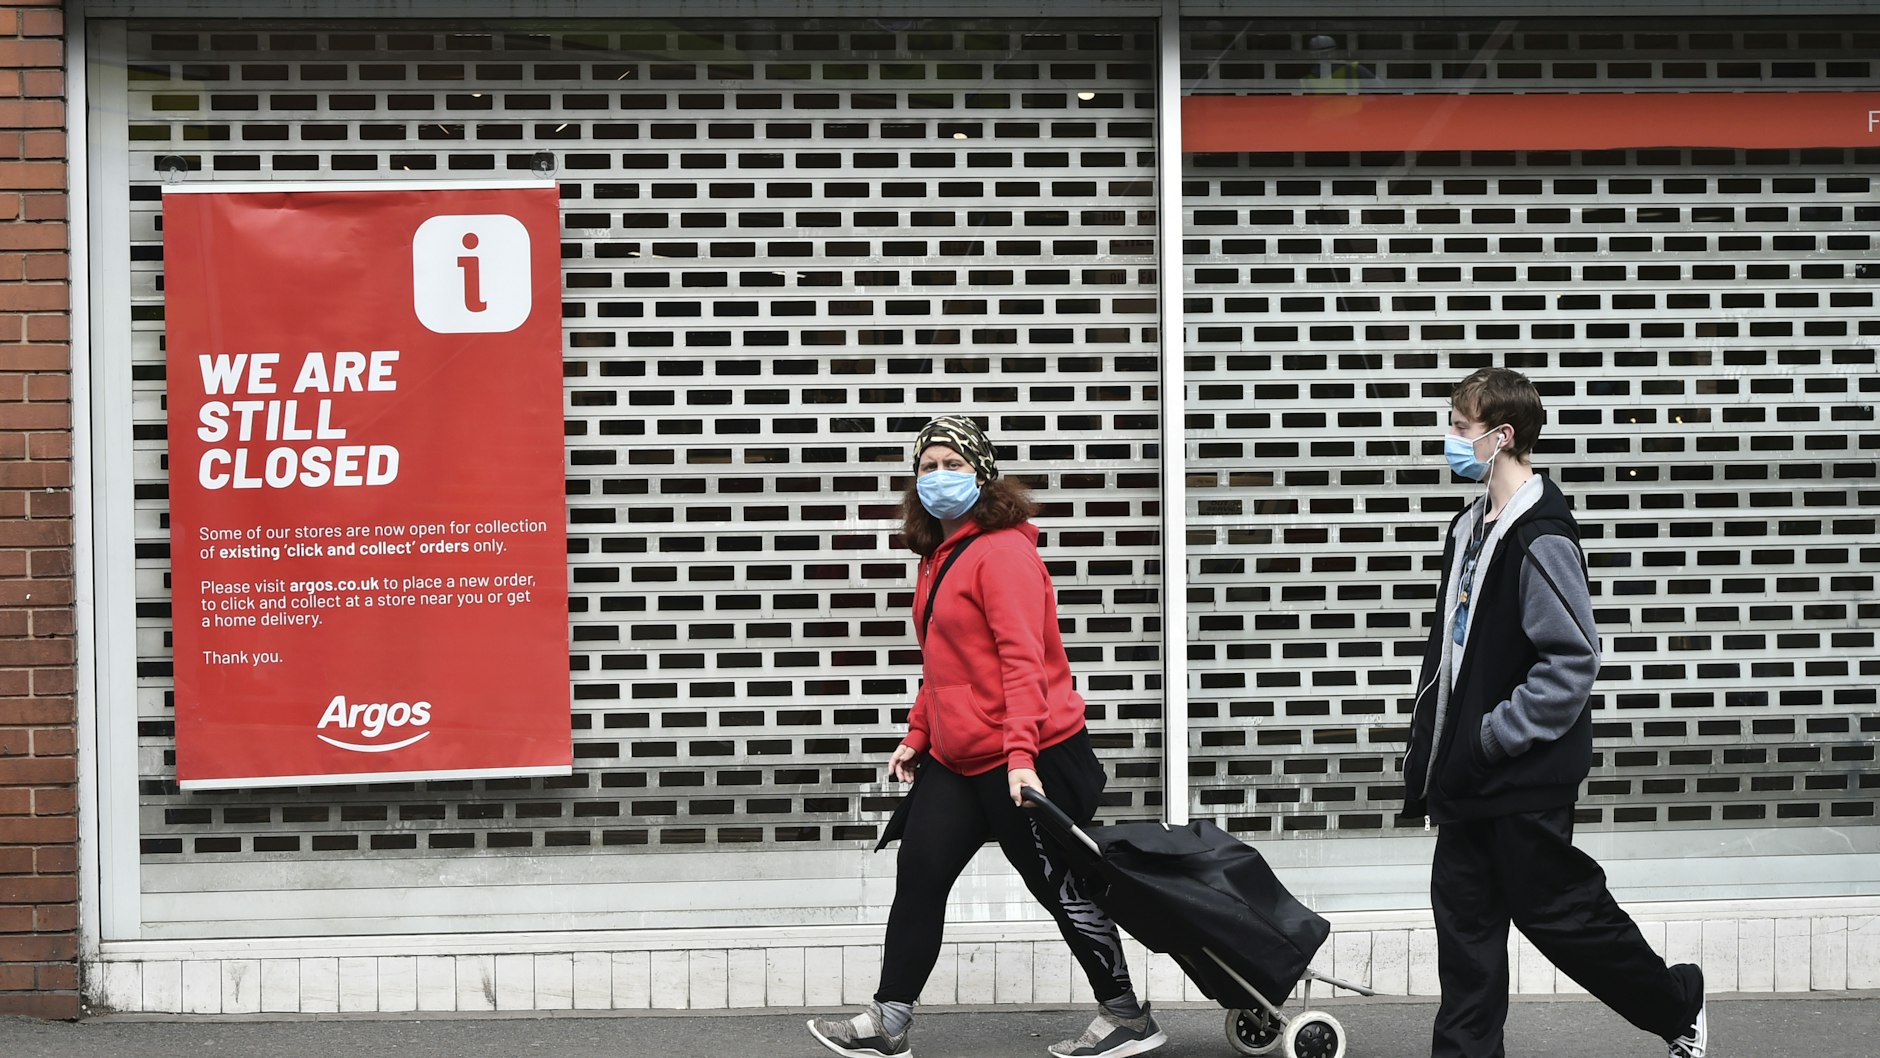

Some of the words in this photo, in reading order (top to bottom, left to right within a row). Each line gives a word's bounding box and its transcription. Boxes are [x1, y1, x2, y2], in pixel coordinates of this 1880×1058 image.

[198, 352, 281, 396] WE
[292, 350, 401, 394] ARE
[196, 398, 347, 443] STILL
[198, 444, 400, 490] CLOSED
[199, 526, 243, 541] Some
[246, 525, 262, 540] of
[265, 528, 291, 539] our
[294, 525, 342, 539] stores
[345, 526, 371, 538] are
[374, 525, 406, 537] now
[409, 523, 446, 539] open
[449, 520, 472, 535] for
[475, 518, 547, 534] collection
[199, 545, 216, 560] of
[219, 543, 281, 561] existing
[326, 541, 356, 557] and
[419, 539, 470, 554] orders
[473, 538, 507, 556] only.
[201, 580, 251, 595] Please
[254, 578, 286, 593] visit
[289, 576, 380, 596] argos.co.uk
[382, 577, 399, 590] to
[402, 575, 443, 593] place
[446, 577, 455, 589] a
[459, 576, 490, 588] new
[493, 572, 536, 588] order,
[200, 598, 217, 611] to
[220, 596, 256, 611] click
[259, 595, 287, 610] and
[290, 594, 341, 609] collect
[345, 594, 361, 608] at
[364, 596, 374, 608] a
[377, 593, 416, 607] store
[420, 593, 454, 605] near
[456, 593, 483, 608] you
[487, 592, 504, 604] or
[506, 589, 531, 607] get
[201, 616, 211, 628] a
[214, 613, 257, 628] home
[260, 611, 323, 628] delivery.
[202, 650, 249, 665] Thank
[252, 652, 283, 667] you.
[316, 694, 432, 738] Argos
